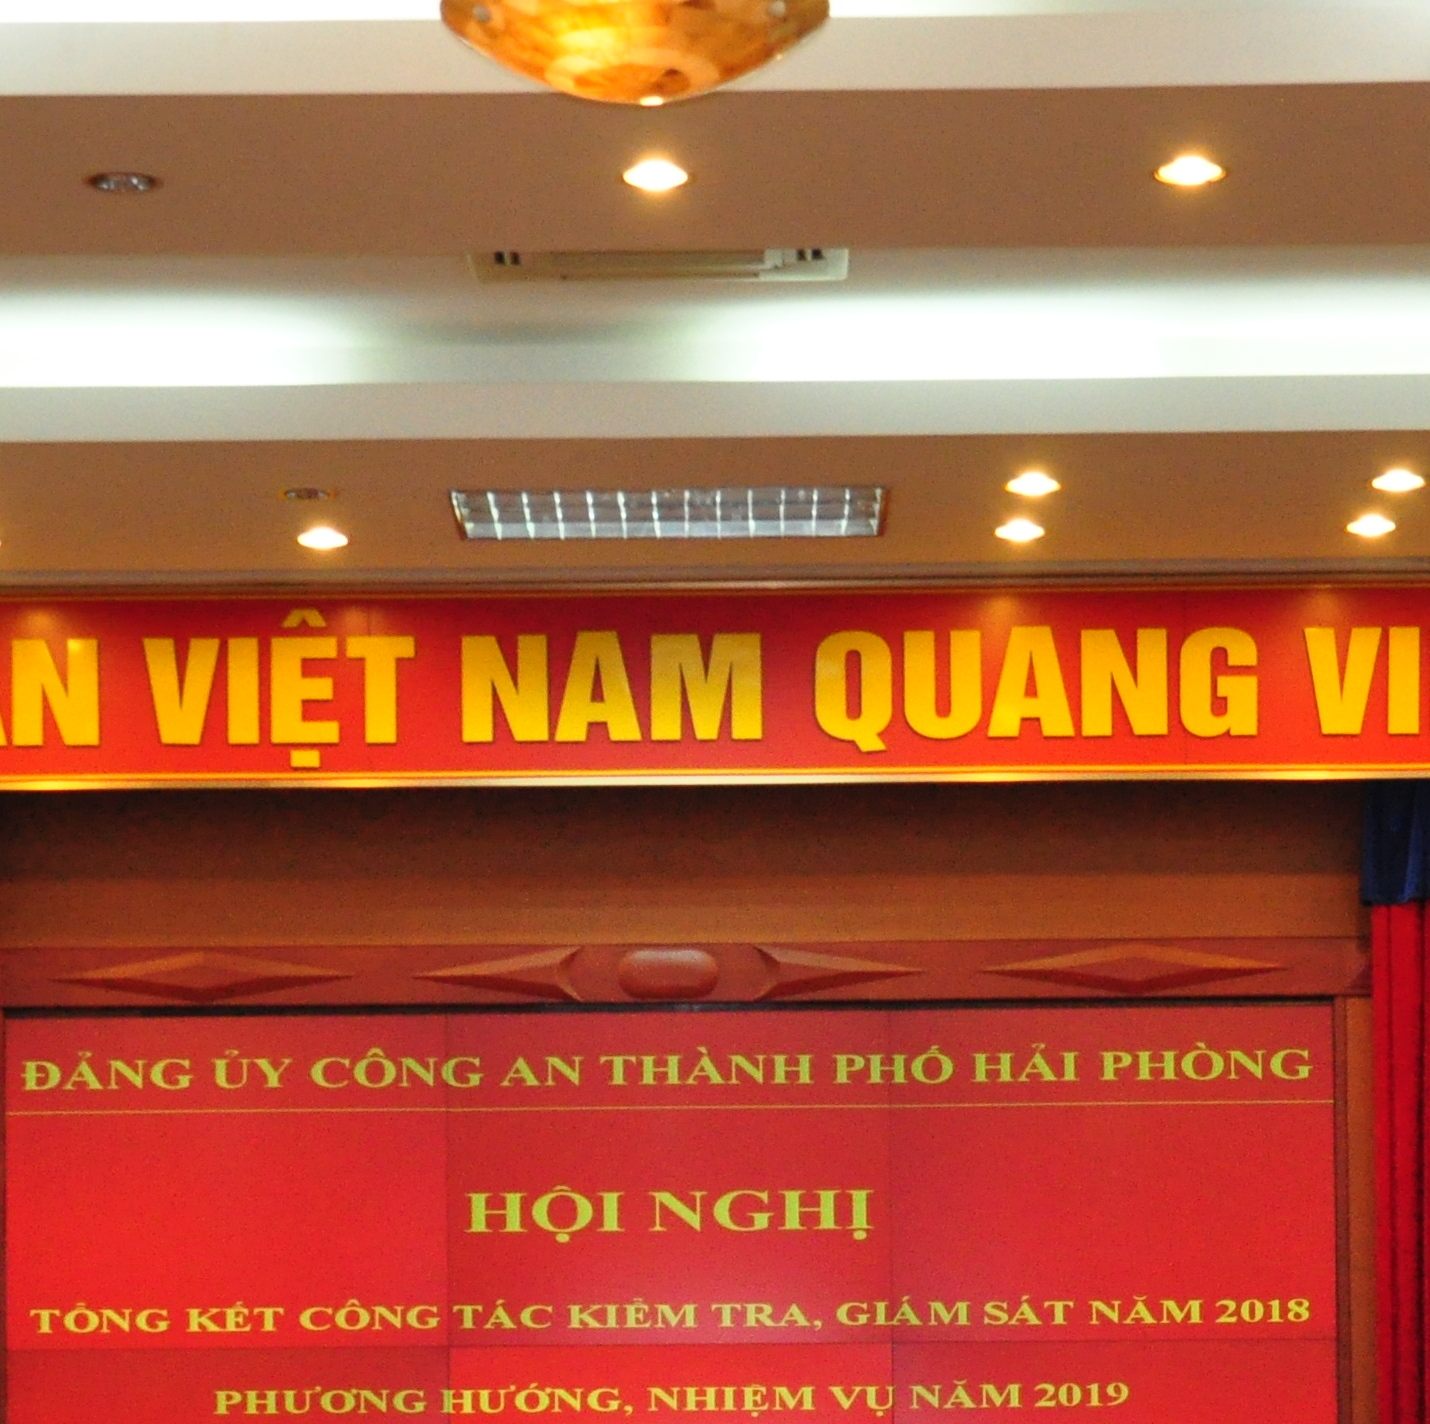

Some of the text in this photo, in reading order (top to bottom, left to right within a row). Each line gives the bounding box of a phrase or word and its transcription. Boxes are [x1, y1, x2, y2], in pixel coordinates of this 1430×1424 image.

[141, 608, 416, 769] VIỆT
[460, 631, 764, 743] NAM
[813, 625, 1260, 754] QUANG
[21, 1040, 1314, 1091] ĐẢNG ỦY CÔNG AN THÀNH PHỐ HẢI PHÒNG
[467, 1184, 873, 1244] HỘI NGHỊ
[28, 1294, 1311, 1334] TỔNG KẾT CÔNG TÁC KIỂM TRA, GIÁM SÁT NĂM 2018
[213, 1379, 1130, 1418] PHƯƠNG HƯỚNG, NHIỆM VỤ NĂM 2019
